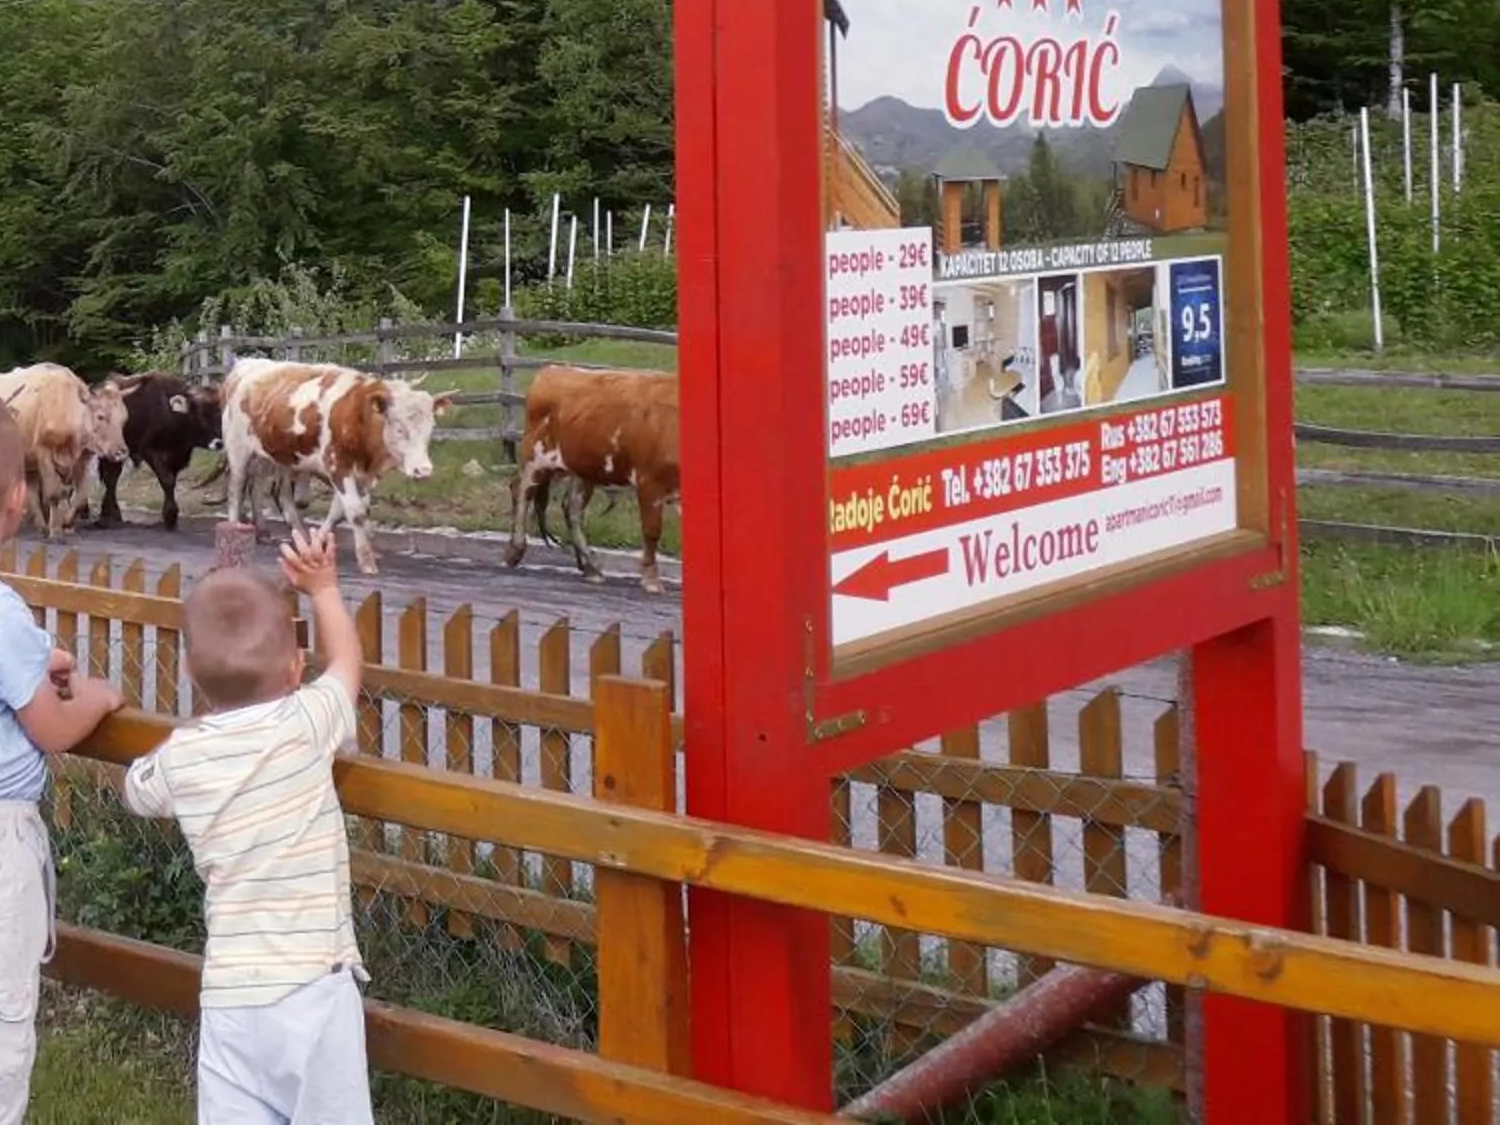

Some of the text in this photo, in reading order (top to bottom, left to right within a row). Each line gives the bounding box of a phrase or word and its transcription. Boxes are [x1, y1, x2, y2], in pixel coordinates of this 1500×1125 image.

[945, 6, 1119, 122] ĆORIĆ
[829, 246, 883, 279] people
[899, 243, 928, 268] 29€
[830, 289, 884, 322] people
[899, 283, 928, 310] 39€
[1182, 303, 1211, 343] 9,5
[830, 329, 885, 363] people
[900, 324, 930, 348] 49€
[831, 369, 885, 404] people
[900, 363, 929, 388] 59€
[831, 409, 886, 445] people
[901, 401, 930, 427] 69€
[1160, 409, 1175, 437] 67
[1162, 440, 1177, 468] 67
[888, 474, 932, 520] Ćorić
[941, 465, 970, 507] Tel.
[974, 457, 1011, 499] +382
[1014, 452, 1033, 491] 67
[1036, 447, 1063, 486] 353
[1065, 441, 1091, 480] 375
[958, 519, 1099, 586] Welcome
